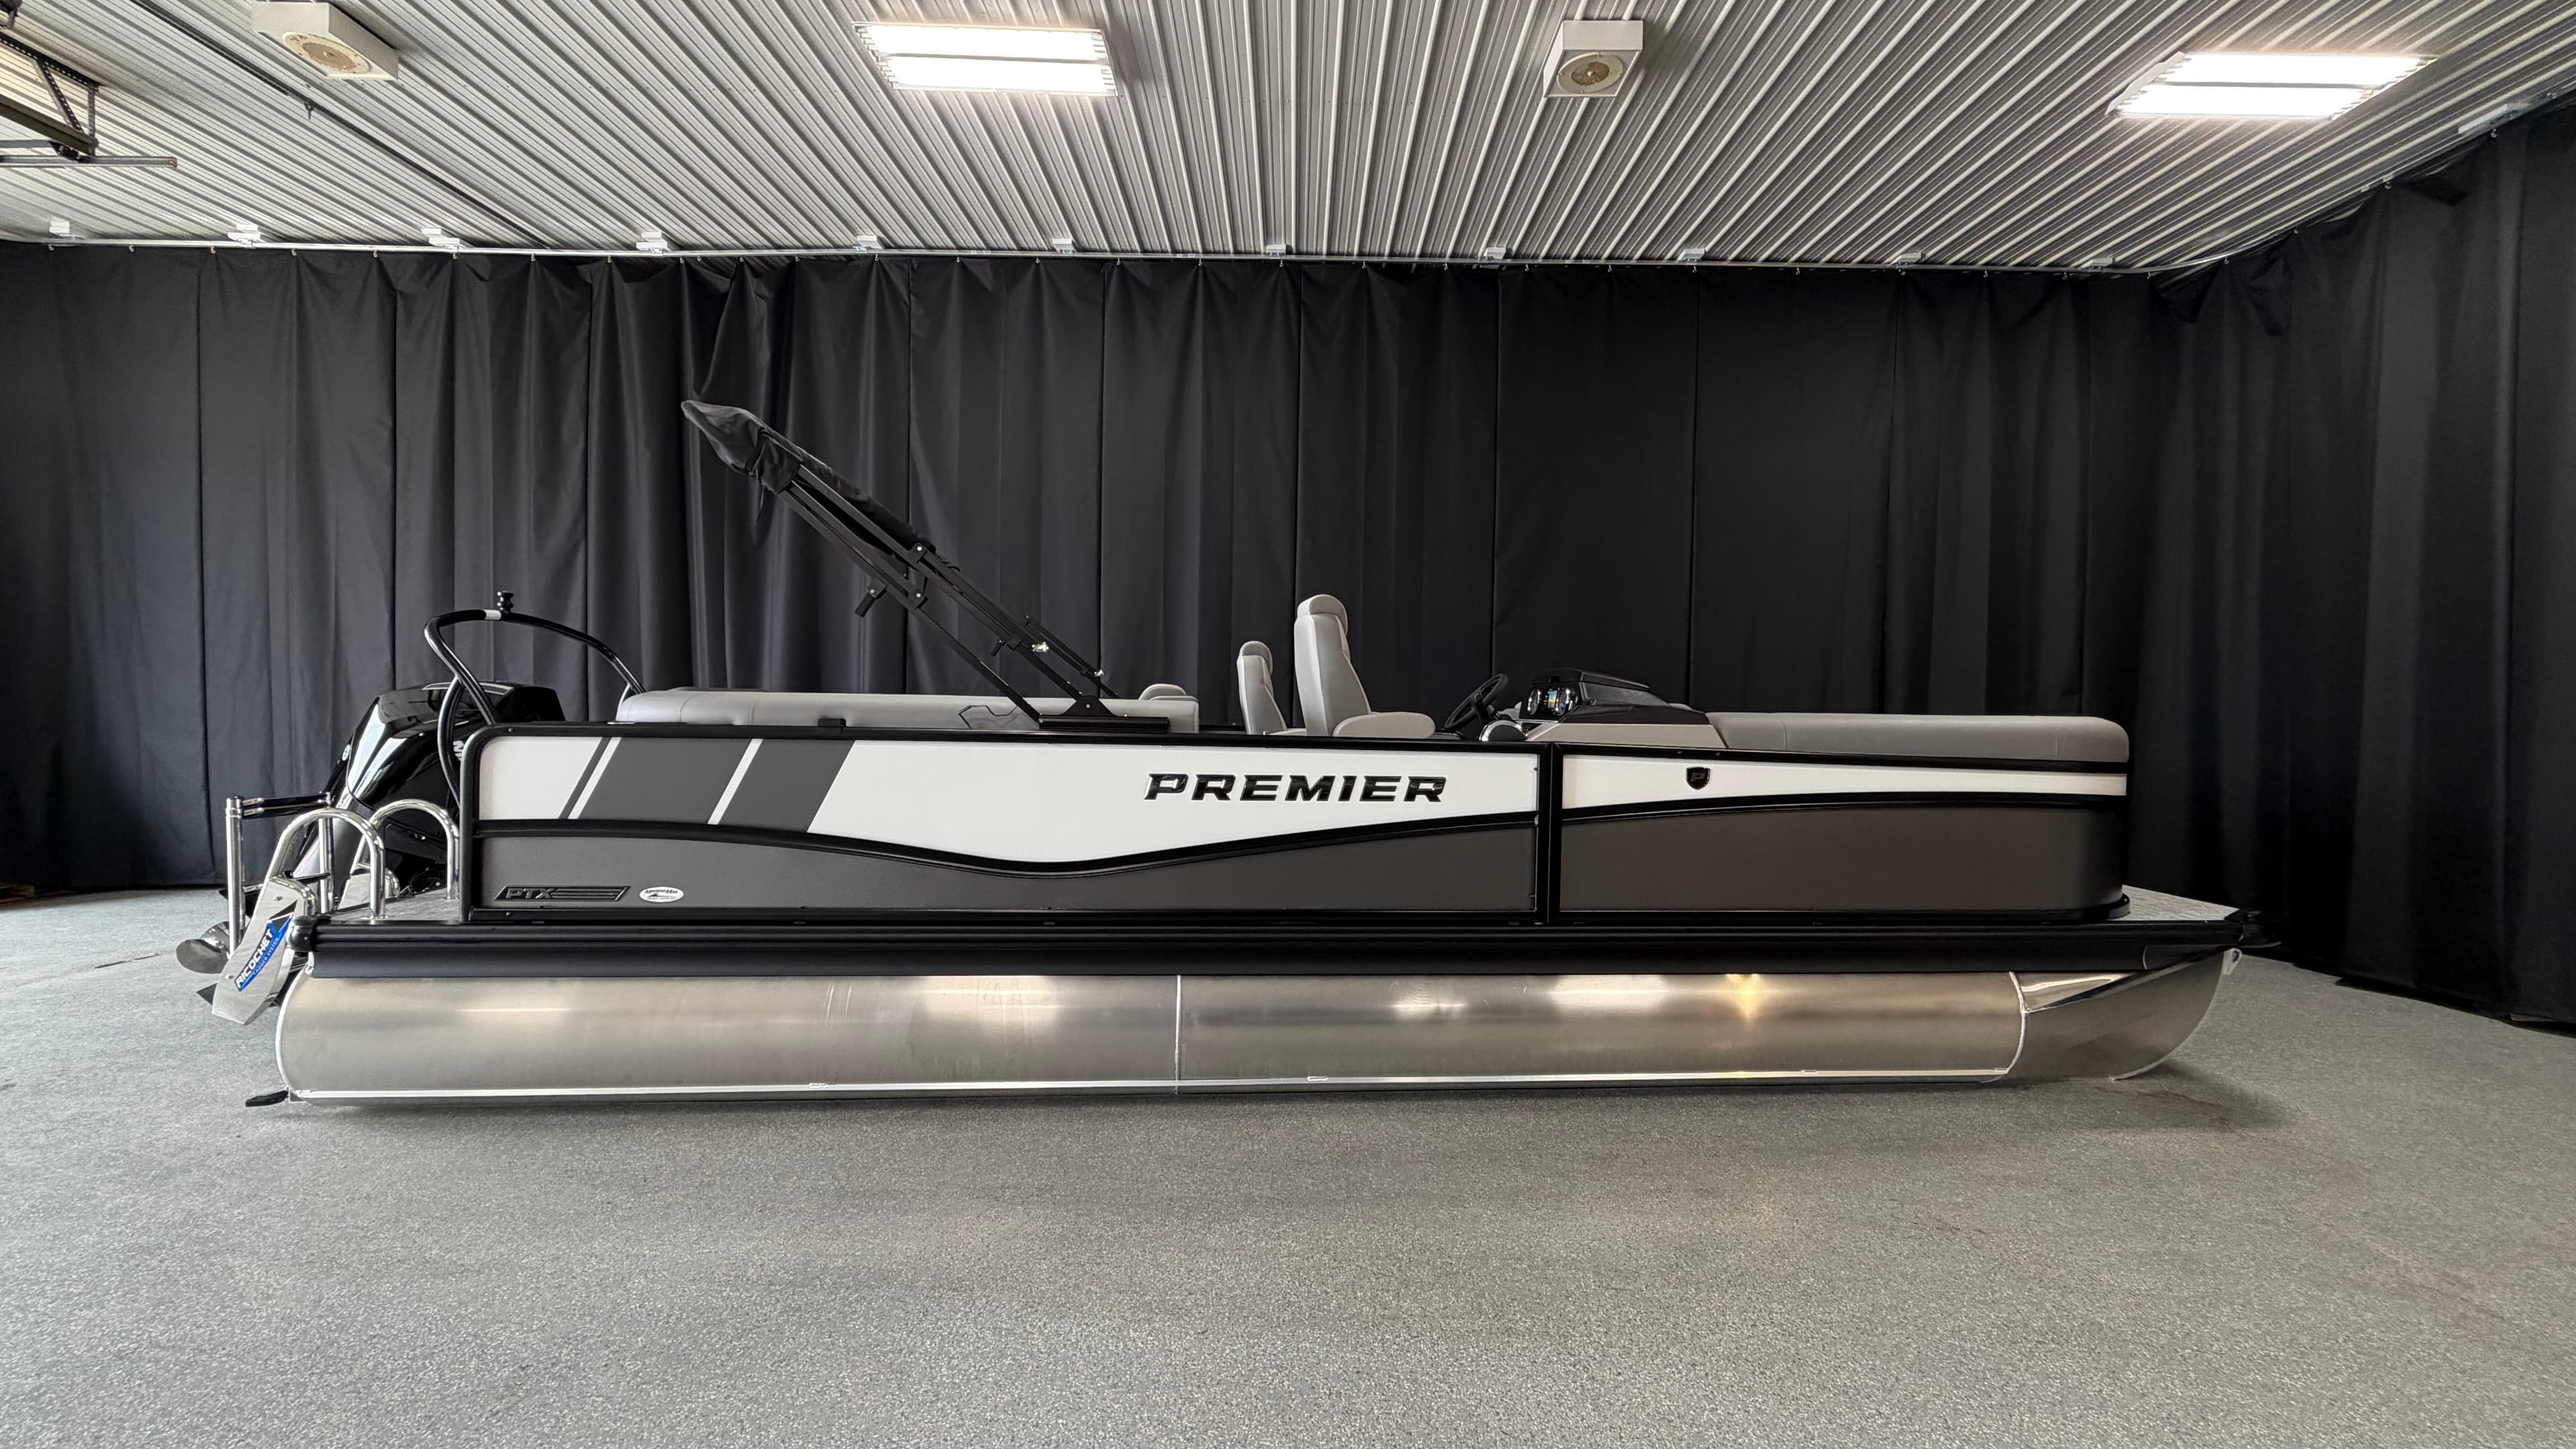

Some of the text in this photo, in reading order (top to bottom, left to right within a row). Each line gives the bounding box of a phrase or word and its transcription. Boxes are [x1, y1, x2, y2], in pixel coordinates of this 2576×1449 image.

[1143, 773, 1447, 803] PREMIER
[505, 888, 556, 899] PTX
[235, 928, 272, 989] RICOCHET
